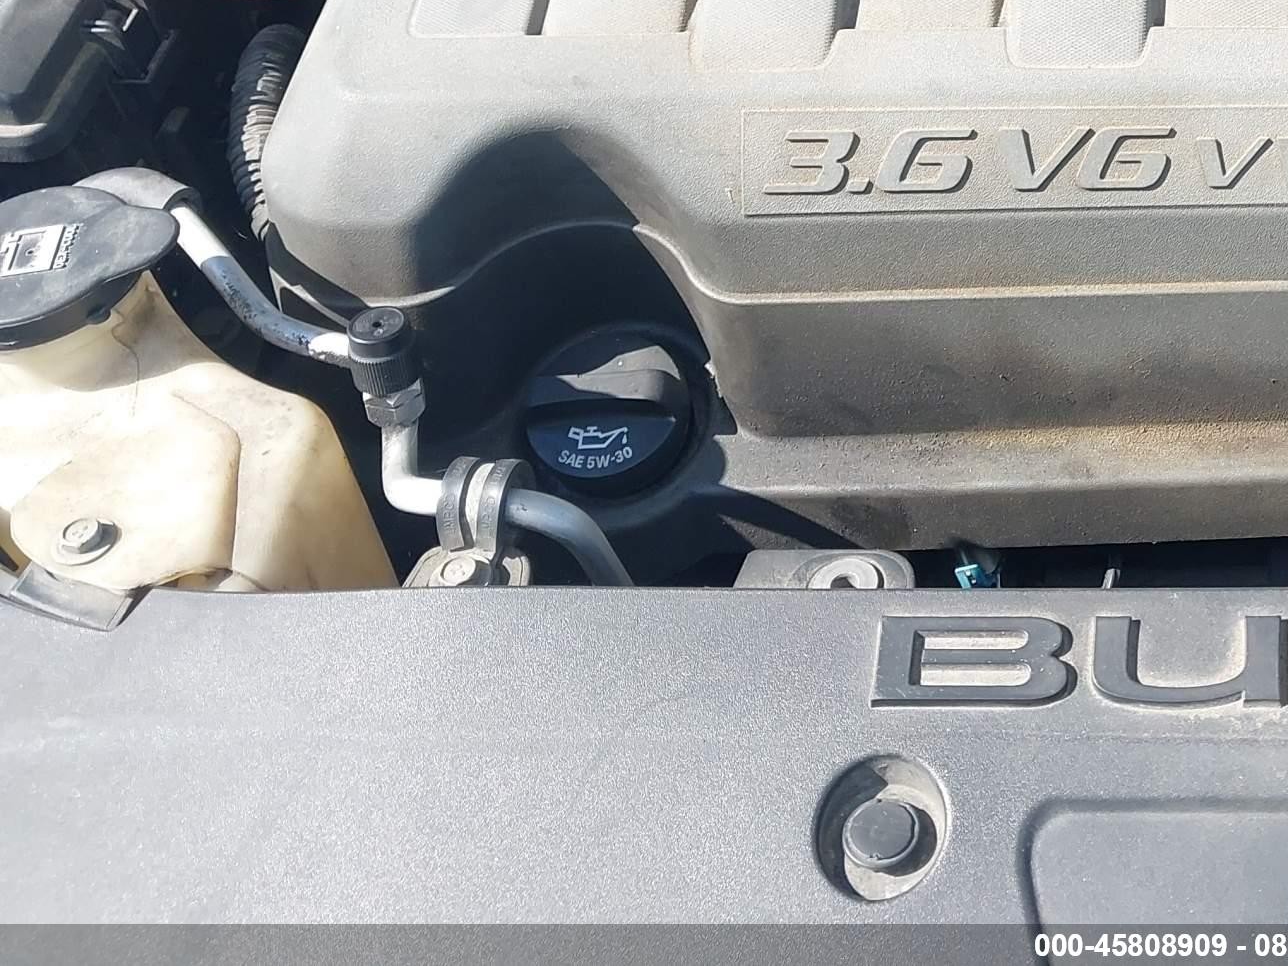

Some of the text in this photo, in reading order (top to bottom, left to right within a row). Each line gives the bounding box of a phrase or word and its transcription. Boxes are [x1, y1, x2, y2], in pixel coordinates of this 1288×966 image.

[763, 127, 978, 195] 3.6
[1000, 125, 1178, 193] V6
[558, 446, 633, 469] SAE 5W-30
